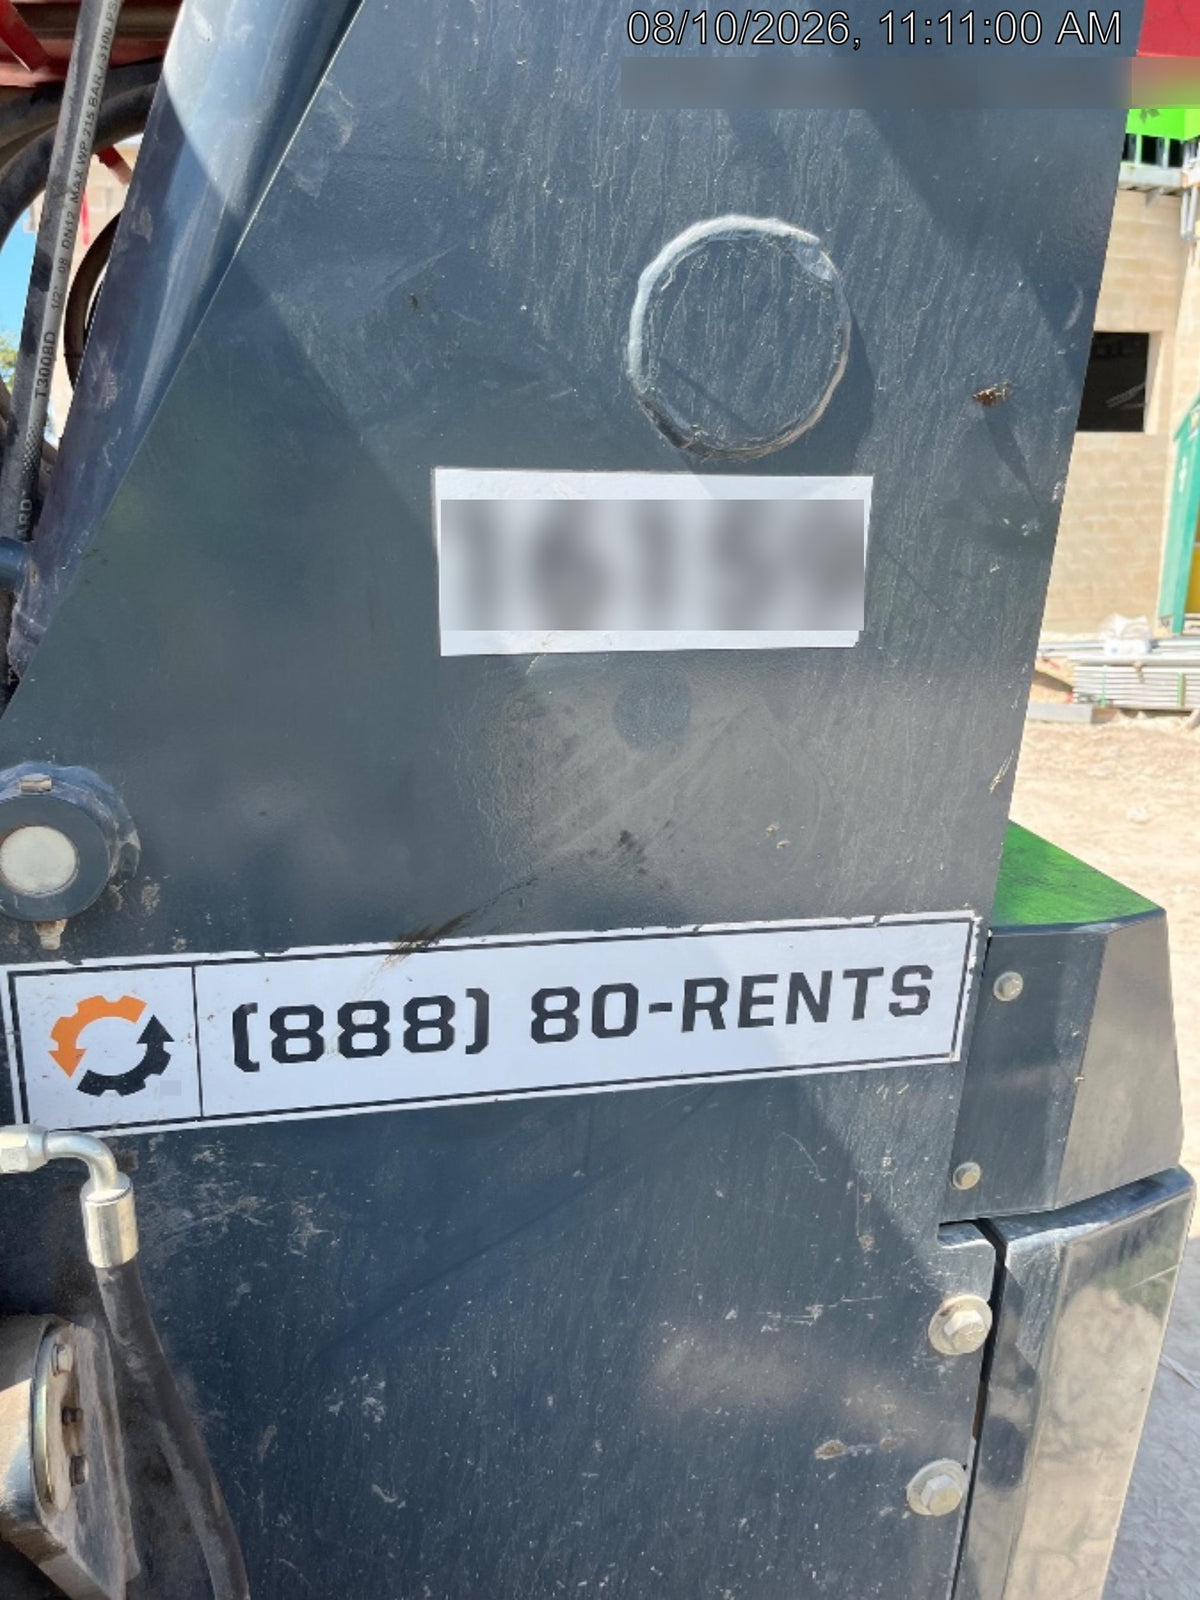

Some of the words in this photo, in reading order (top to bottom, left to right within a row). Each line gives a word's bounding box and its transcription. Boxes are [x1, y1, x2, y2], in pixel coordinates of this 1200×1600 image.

[105, 0, 119, 21] PS
[88, 74, 104, 108] BAR
[76, 140, 88, 164] WP
[69, 169, 84, 204] MAX
[61, 211, 75, 249] DN12
[35, 331, 56, 399] T3008D
[232, 988, 490, 1073] (888)
[531, 965, 934, 1044] 80-RENTS
